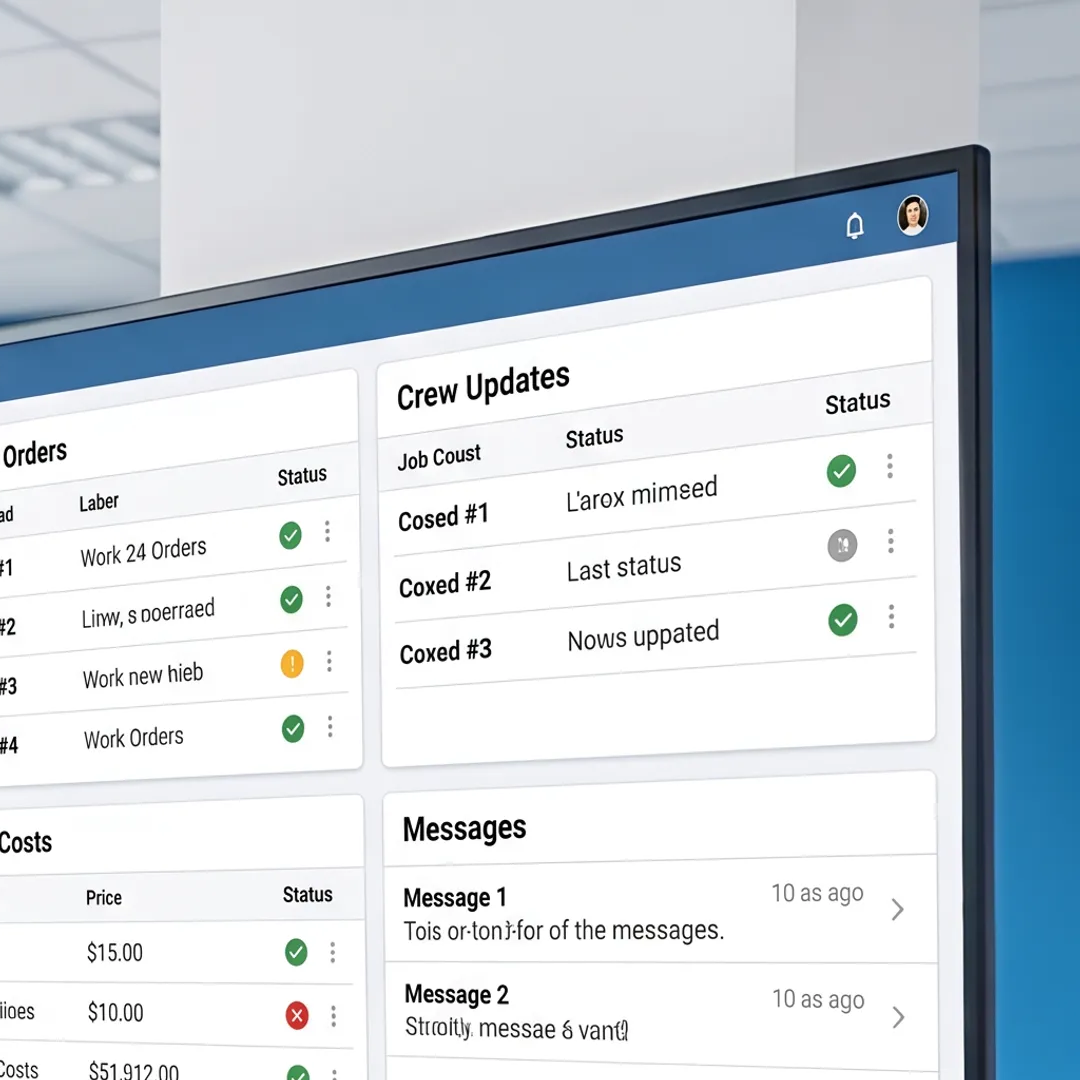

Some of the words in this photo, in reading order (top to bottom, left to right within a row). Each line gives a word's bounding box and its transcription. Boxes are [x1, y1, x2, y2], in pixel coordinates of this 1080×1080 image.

[398, 383, 458, 410] Crew
[466, 366, 569, 405] Updates
[826, 393, 890, 415] Status
[566, 428, 623, 449] Status
[3, 440, 67, 468] Orders
[398, 450, 428, 471] Job
[433, 444, 481, 466] Coust
[278, 468, 327, 486] Status
[80, 493, 119, 512] Laber
[399, 504, 458, 532] Cosed
[464, 502, 487, 524] #1
[81, 545, 121, 567] Work
[126, 543, 146, 563] 24
[152, 538, 206, 560] Orders
[568, 559, 610, 582] Last
[617, 555, 681, 577] status
[400, 572, 459, 598] Coxed
[465, 570, 491, 591] #2
[569, 630, 626, 651] Nows
[634, 618, 719, 651] uppated
[400, 640, 460, 664] Coxed
[466, 638, 492, 659] #3
[83, 668, 124, 689] Work
[129, 669, 163, 685] new
[168, 661, 203, 682] hieb
[84, 728, 125, 749] Work
[130, 727, 183, 747] Orders
[404, 816, 526, 847] Messages
[87, 889, 122, 905] Price
[283, 886, 333, 903] Status
[404, 888, 490, 912] Message
[497, 886, 505, 907] 1
[773, 883, 794, 902] 10
[801, 887, 821, 901] as
[828, 887, 863, 906] ago
[404, 921, 441, 940] Tois
[550, 919, 569, 940] of
[574, 918, 606, 940] the
[613, 924, 724, 945] messages.
[87, 941, 142, 963] $15.00
[405, 983, 491, 1009] Message
[497, 984, 509, 1005] 2
[773, 989, 795, 1008] 10
[802, 994, 822, 1008] as
[829, 994, 864, 1014] ago
[88, 1000, 143, 1023] $10.00
[480, 1022, 555, 1039] messae
